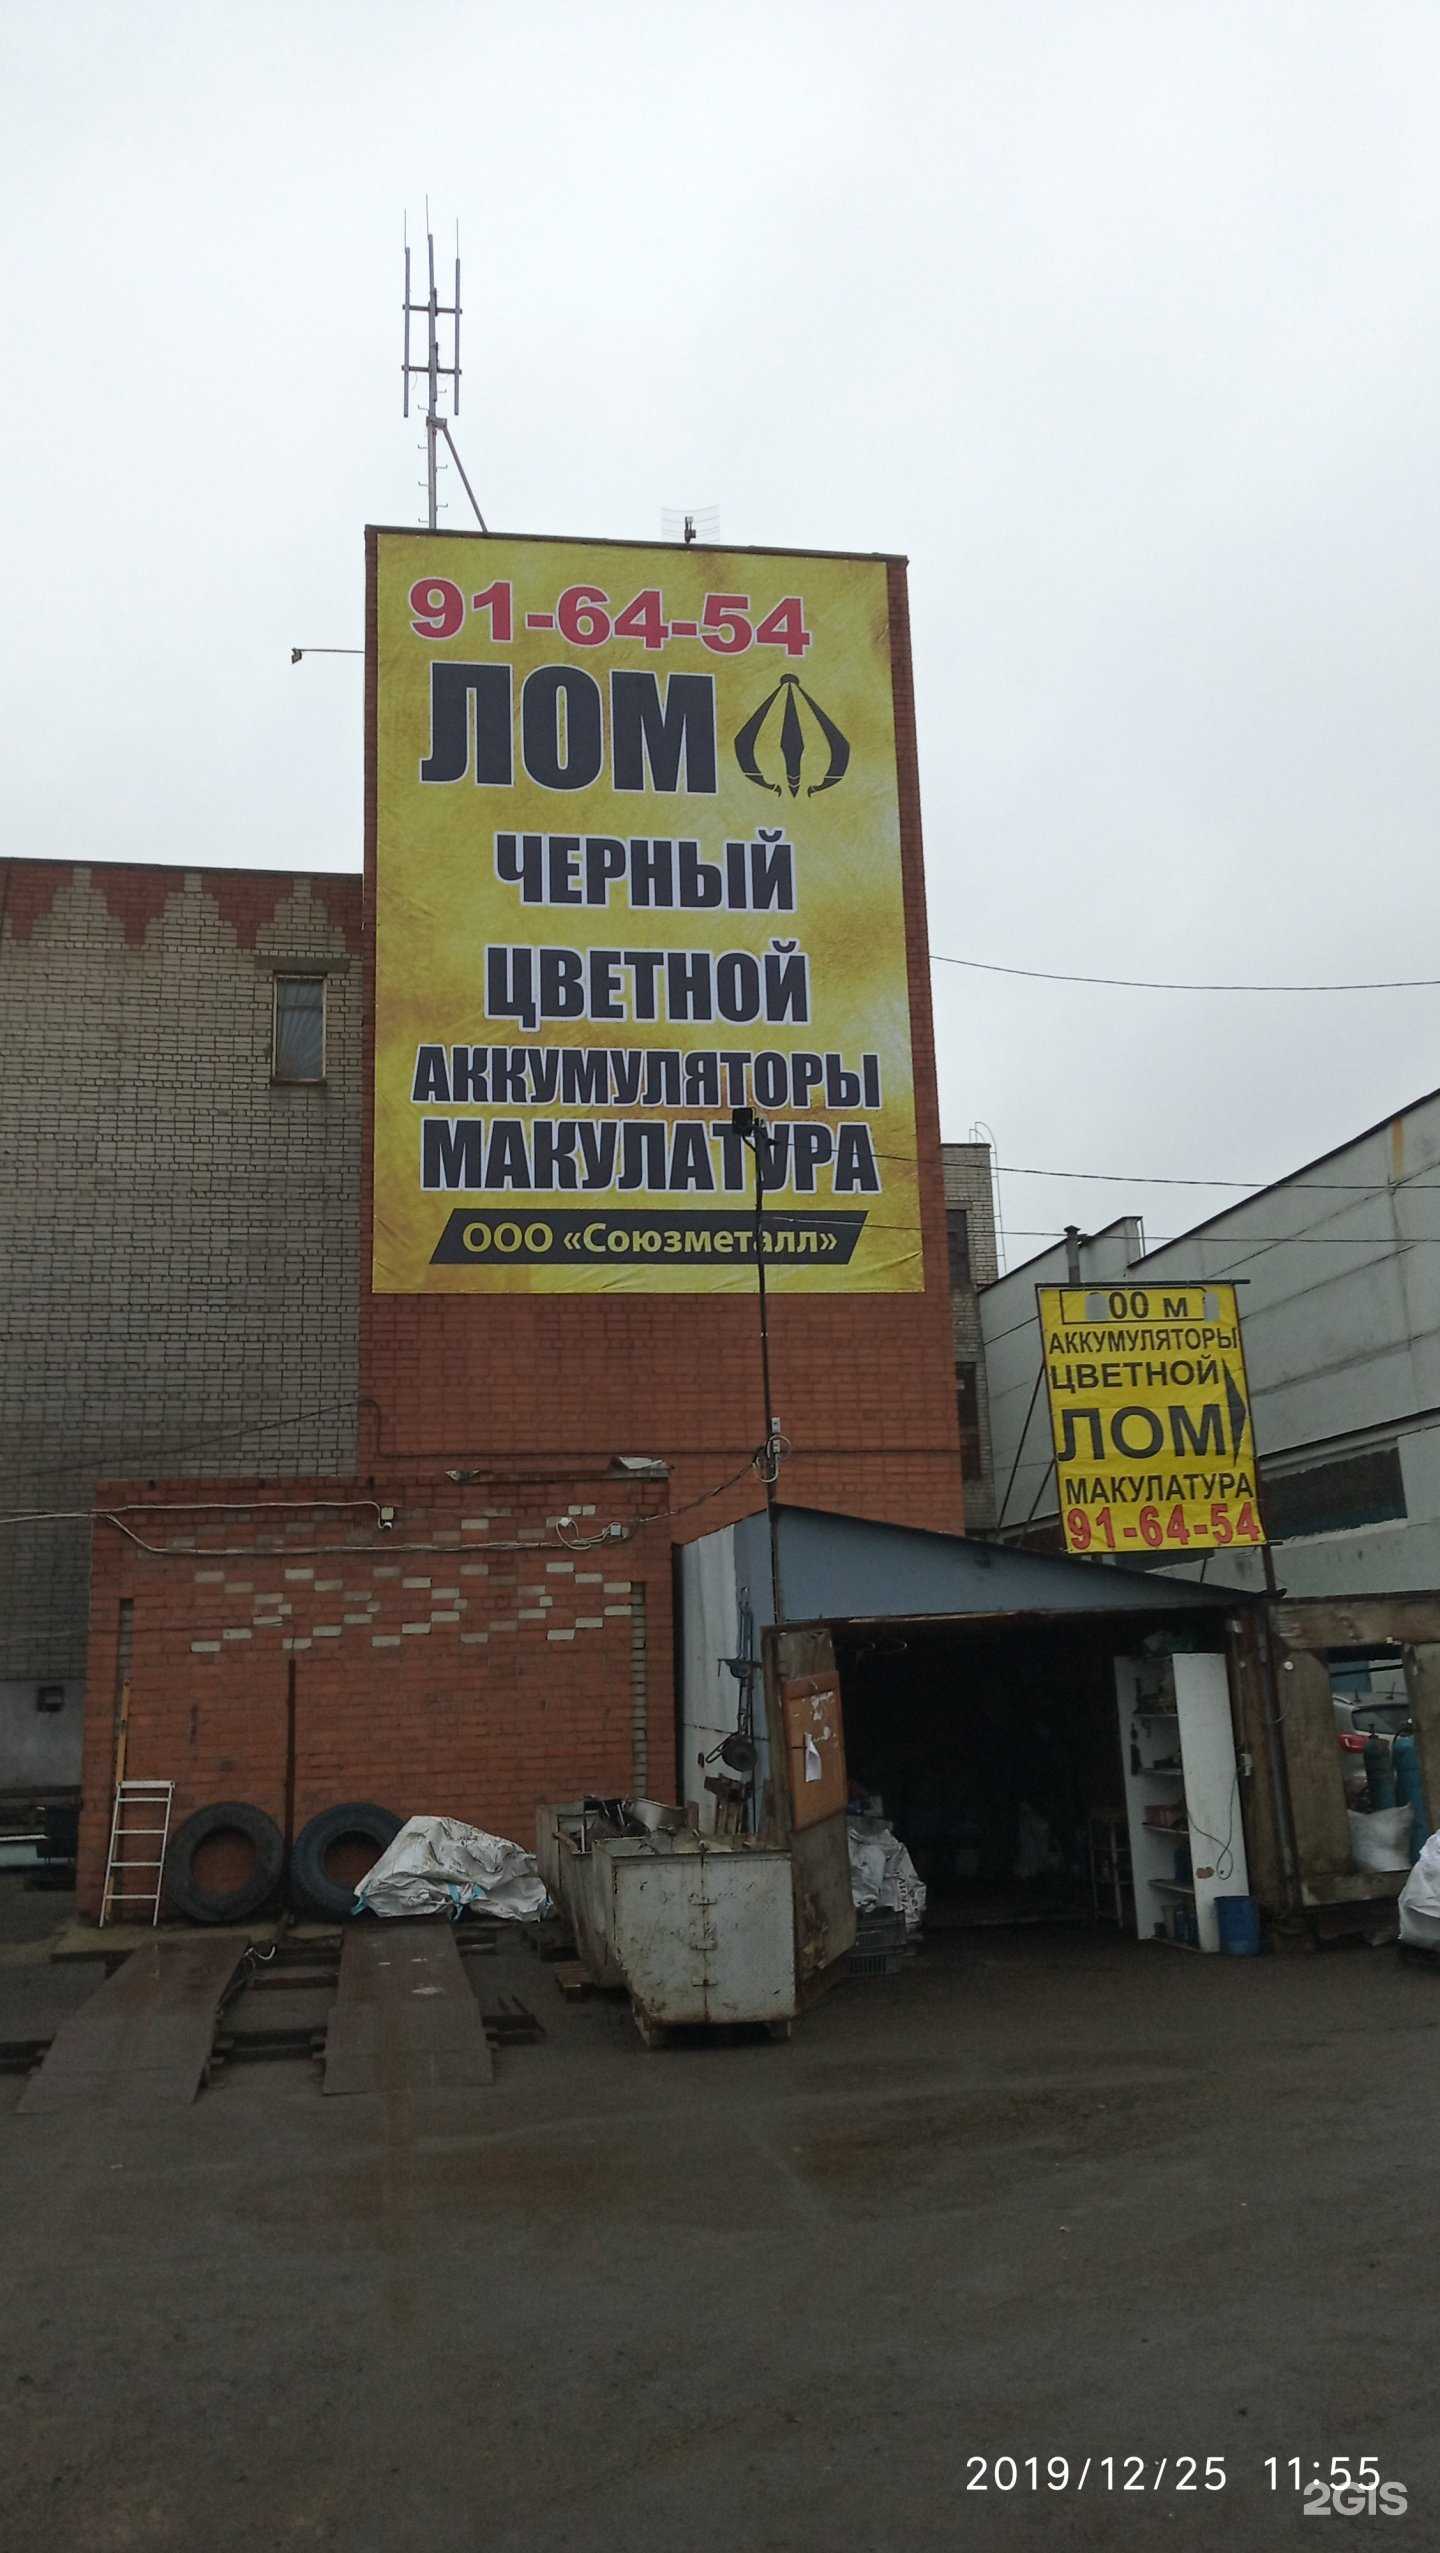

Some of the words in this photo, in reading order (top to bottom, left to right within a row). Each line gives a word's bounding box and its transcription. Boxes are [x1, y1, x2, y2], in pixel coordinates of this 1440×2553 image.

[408, 577, 811, 657] 91-64-54
[419, 661, 717, 794] ЛОМ
[495, 828, 797, 912] ЧЕРНЫЙ
[484, 938, 810, 1032] ЦВЕТНОЙ
[411, 1044, 881, 1109] АККУМУЛЯТОРЫ
[420, 1117, 880, 1193] МАКУЛАТУРА
[462, 1222, 553, 1253] ООО
[1049, 1327, 1238, 1355] АККУМУЛЯТОРЫ
[1051, 1354, 1219, 1394] ЦВЕТНОЙ
[1057, 1403, 1227, 1462] ЛОМ
[1065, 1473, 1254, 1505] МАКУЛАТУРА
[1067, 1501, 1262, 1550] 91-64-54
